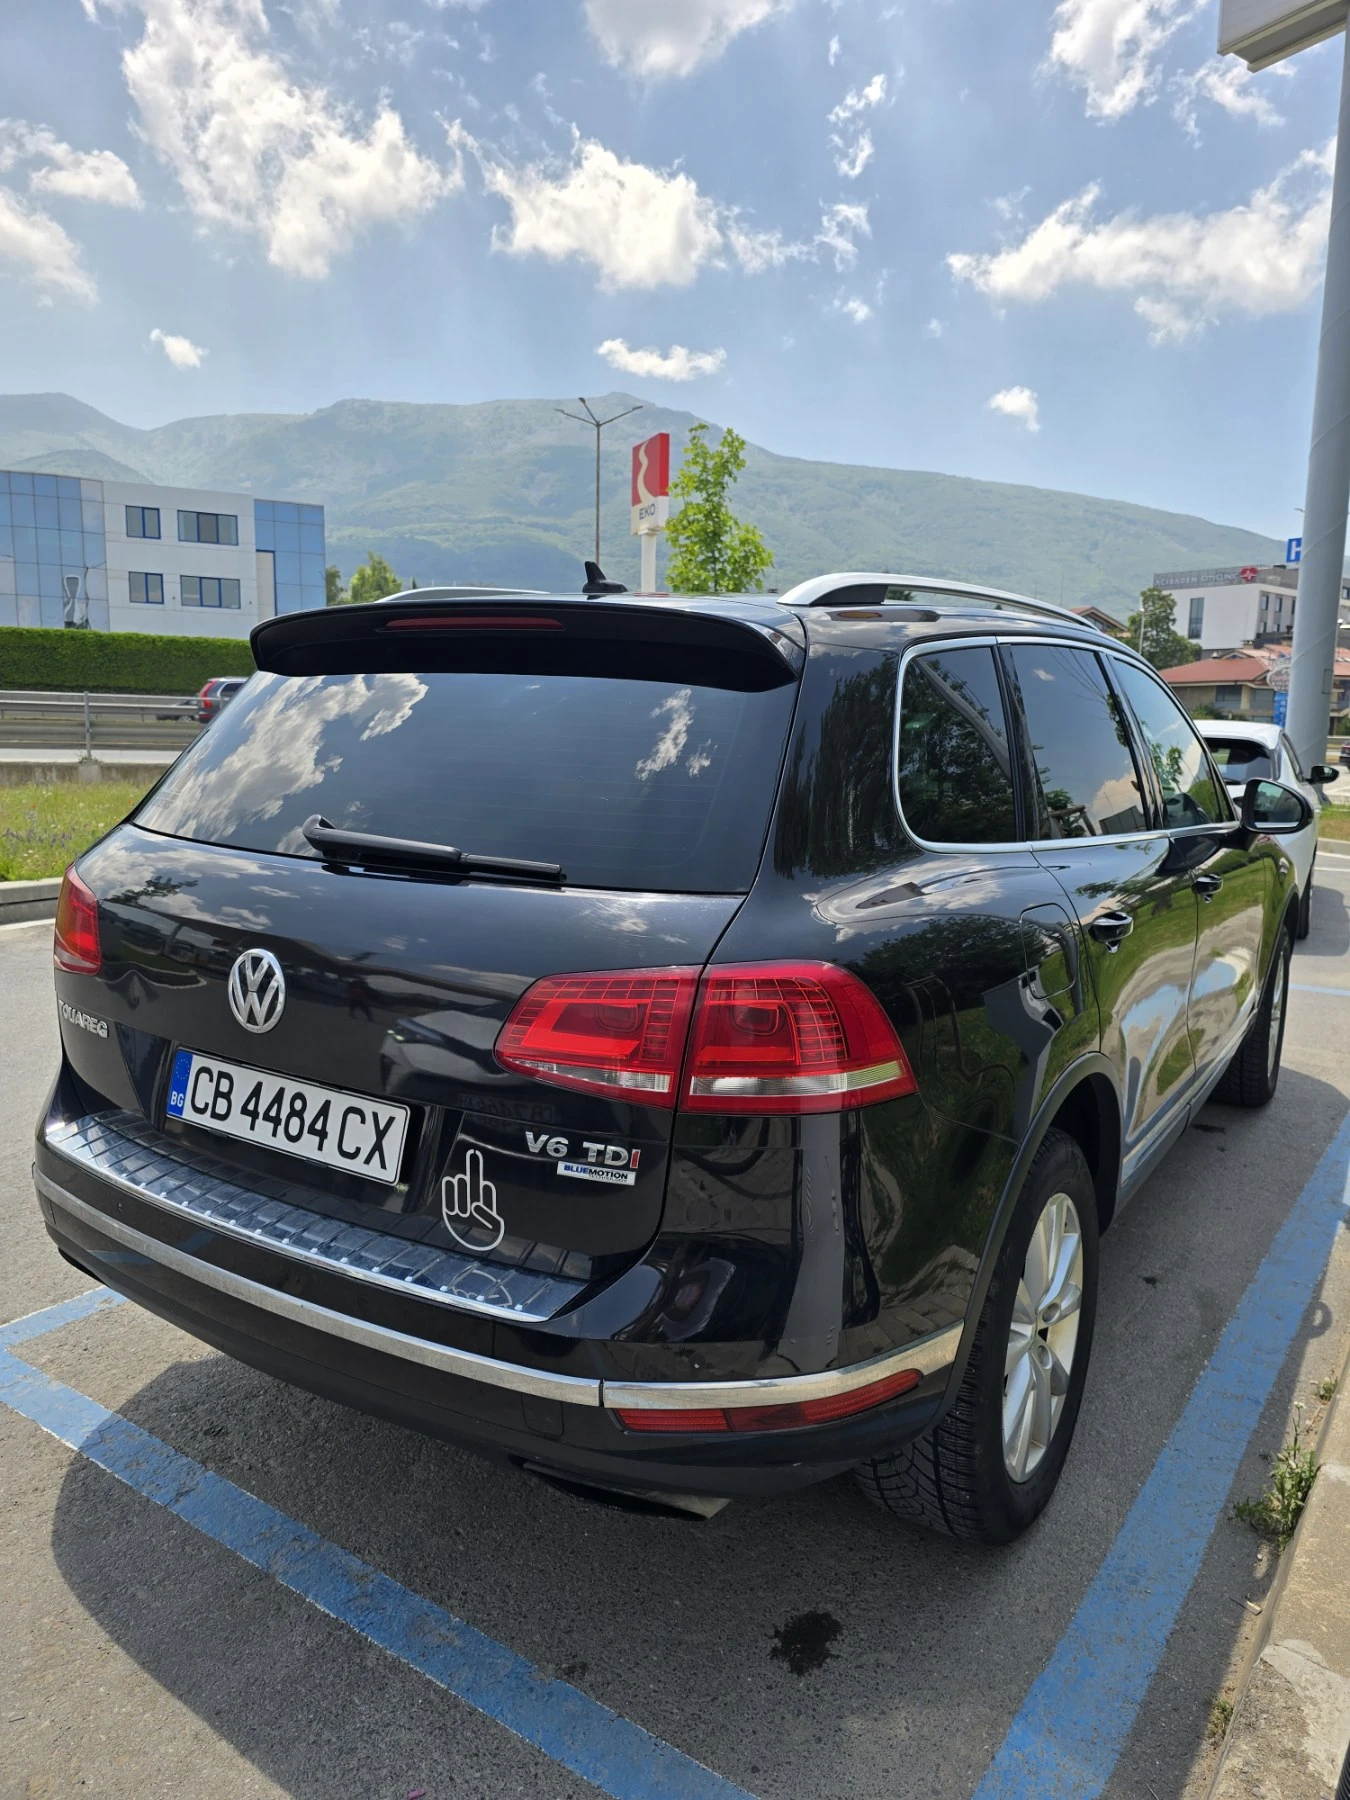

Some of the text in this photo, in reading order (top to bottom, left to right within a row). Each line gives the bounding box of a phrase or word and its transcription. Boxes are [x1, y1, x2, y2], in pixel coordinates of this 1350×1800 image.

[639, 503, 656, 520] EKO
[58, 999, 108, 1038] TOUAREG
[170, 1090, 184, 1108] BG
[190, 1066, 234, 1122] CB
[240, 1080, 332, 1151] 4484
[337, 1105, 396, 1170] CX
[525, 1131, 641, 1169] V6 TDI
[563, 1164, 628, 1180] BLUEMOTION
